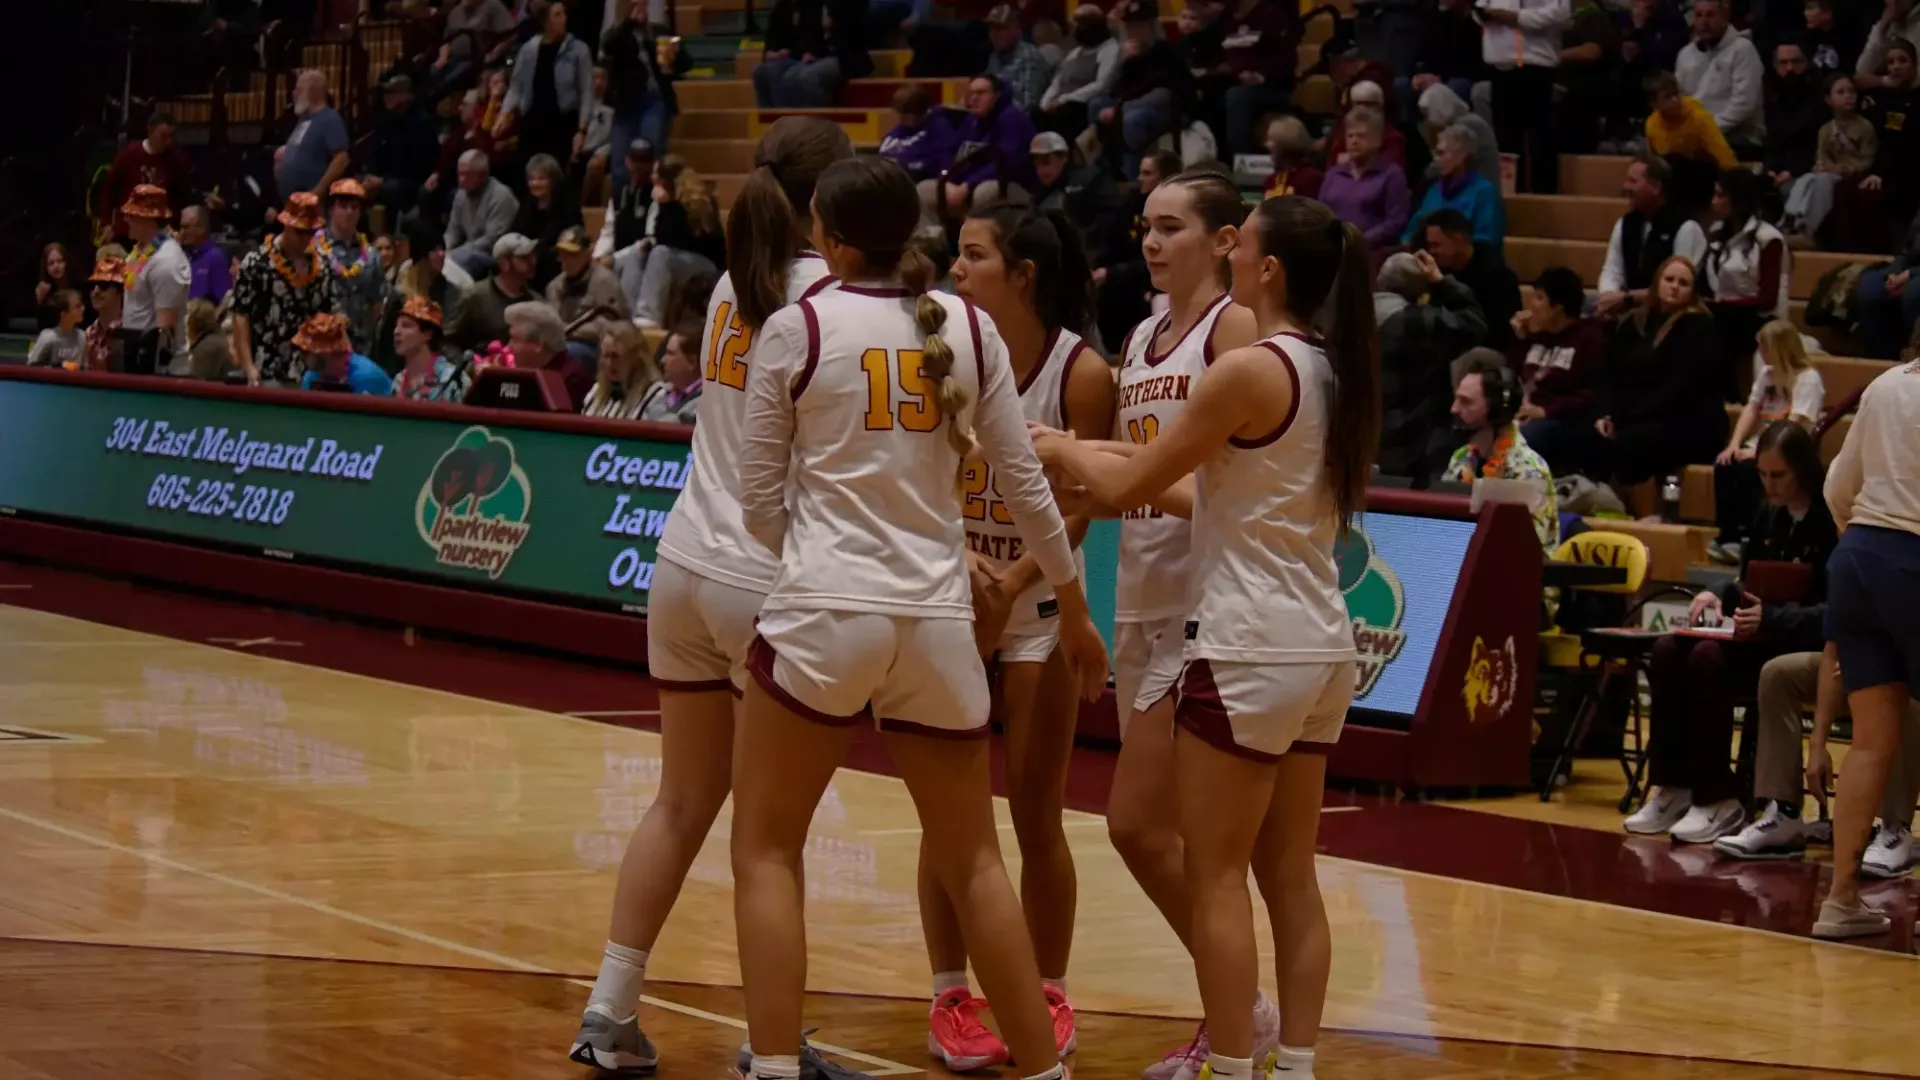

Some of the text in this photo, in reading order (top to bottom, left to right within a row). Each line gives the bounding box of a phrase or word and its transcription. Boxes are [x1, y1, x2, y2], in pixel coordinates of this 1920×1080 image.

[706, 300, 755, 392] 12
[860, 347, 943, 433] 15
[1119, 374, 1191, 411] ORTHERN
[105, 416, 384, 481] 304 East Melgaard Road
[145, 472, 296, 527] 605-225-7818
[437, 517, 527, 546] parkview
[964, 530, 1024, 561] TATE
[439, 542, 511, 575] nursery
